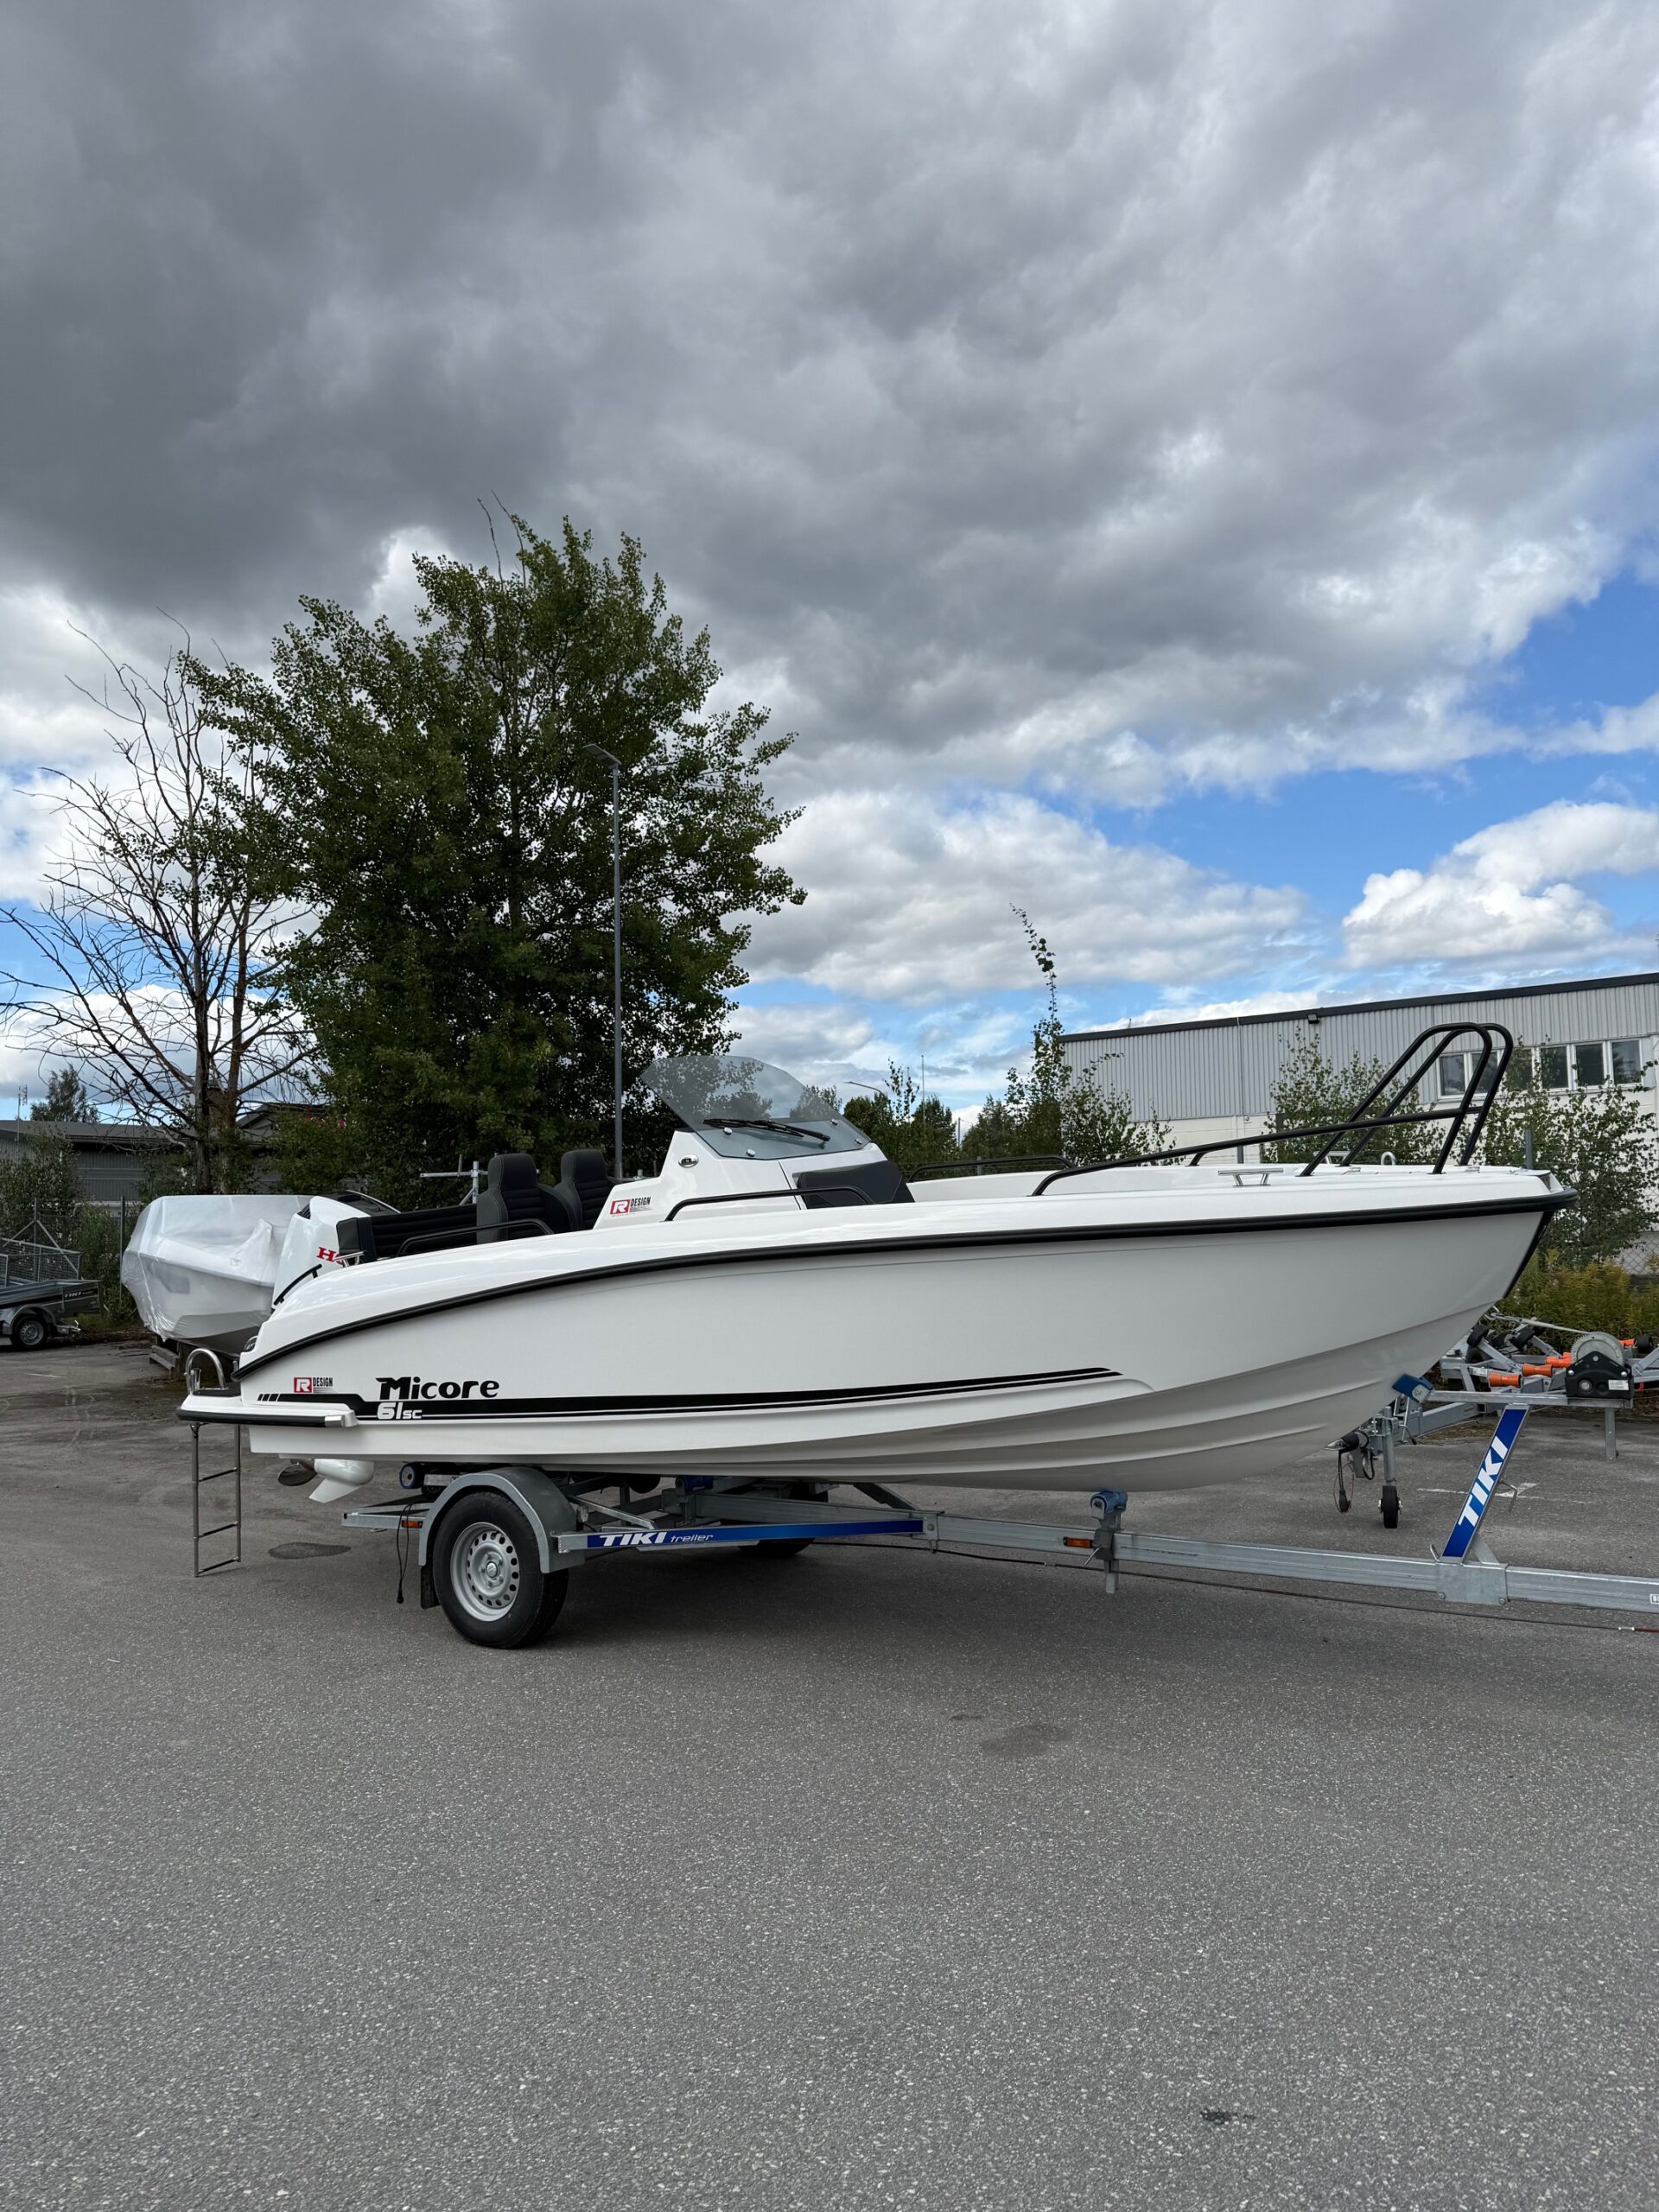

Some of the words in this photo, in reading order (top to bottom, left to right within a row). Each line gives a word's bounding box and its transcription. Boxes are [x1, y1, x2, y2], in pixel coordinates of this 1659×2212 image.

[630, 1196, 652, 1207] DESIGN
[313, 1377, 334, 1388] DESIGN
[376, 1376, 500, 1401] Micore
[1458, 1435, 1509, 1528] TIKI
[600, 1531, 668, 1547] TIKI
